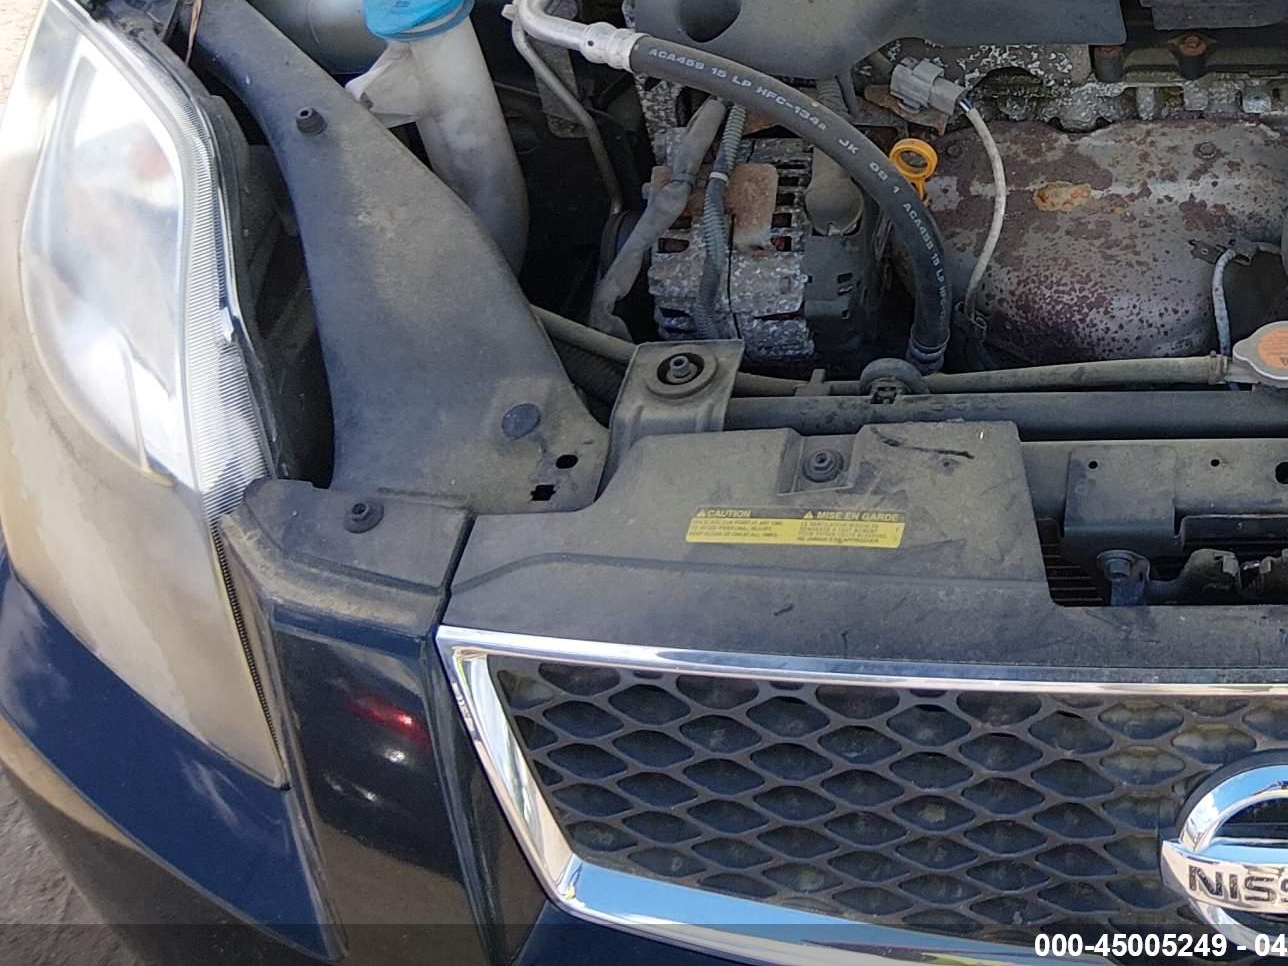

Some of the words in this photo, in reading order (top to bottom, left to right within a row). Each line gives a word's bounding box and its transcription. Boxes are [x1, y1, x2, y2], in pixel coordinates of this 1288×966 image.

[732, 76, 752, 87] LP
[838, 138, 859, 154] JK
[706, 509, 752, 518] CAUTION
[817, 511, 843, 520] MISE
[845, 512, 859, 520] EN
[861, 513, 899, 522] GARDE
